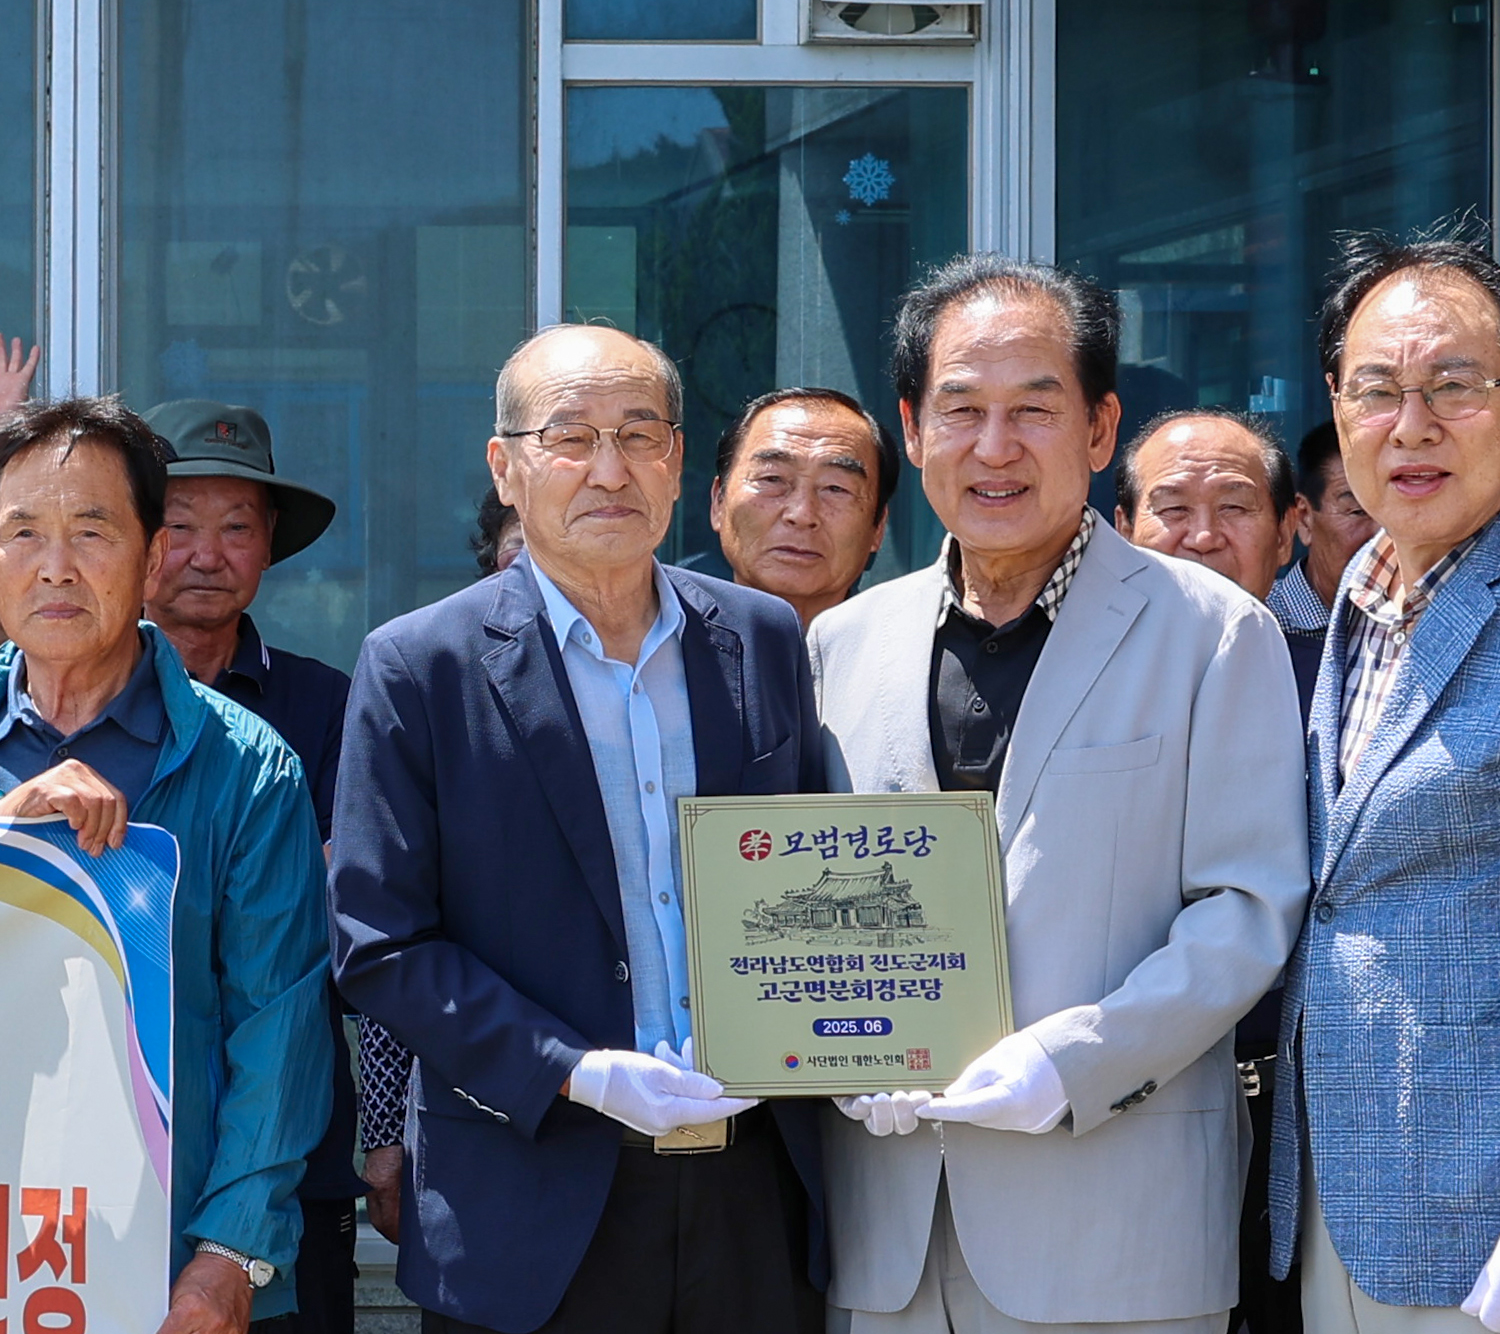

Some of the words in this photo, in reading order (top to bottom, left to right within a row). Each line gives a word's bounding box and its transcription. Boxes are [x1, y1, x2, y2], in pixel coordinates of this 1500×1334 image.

[778, 825, 938, 861] 모범경로당
[729, 954, 865, 975] 전라남도연합회
[870, 952, 967, 973] 진도군지회
[757, 977, 944, 1003] 고군면분회경로당
[822, 1020, 860, 1035] 2025.
[864, 1020, 883, 1034] 06
[806, 1055, 849, 1069] 사단법인
[851, 1054, 905, 1067] 대한노인회
